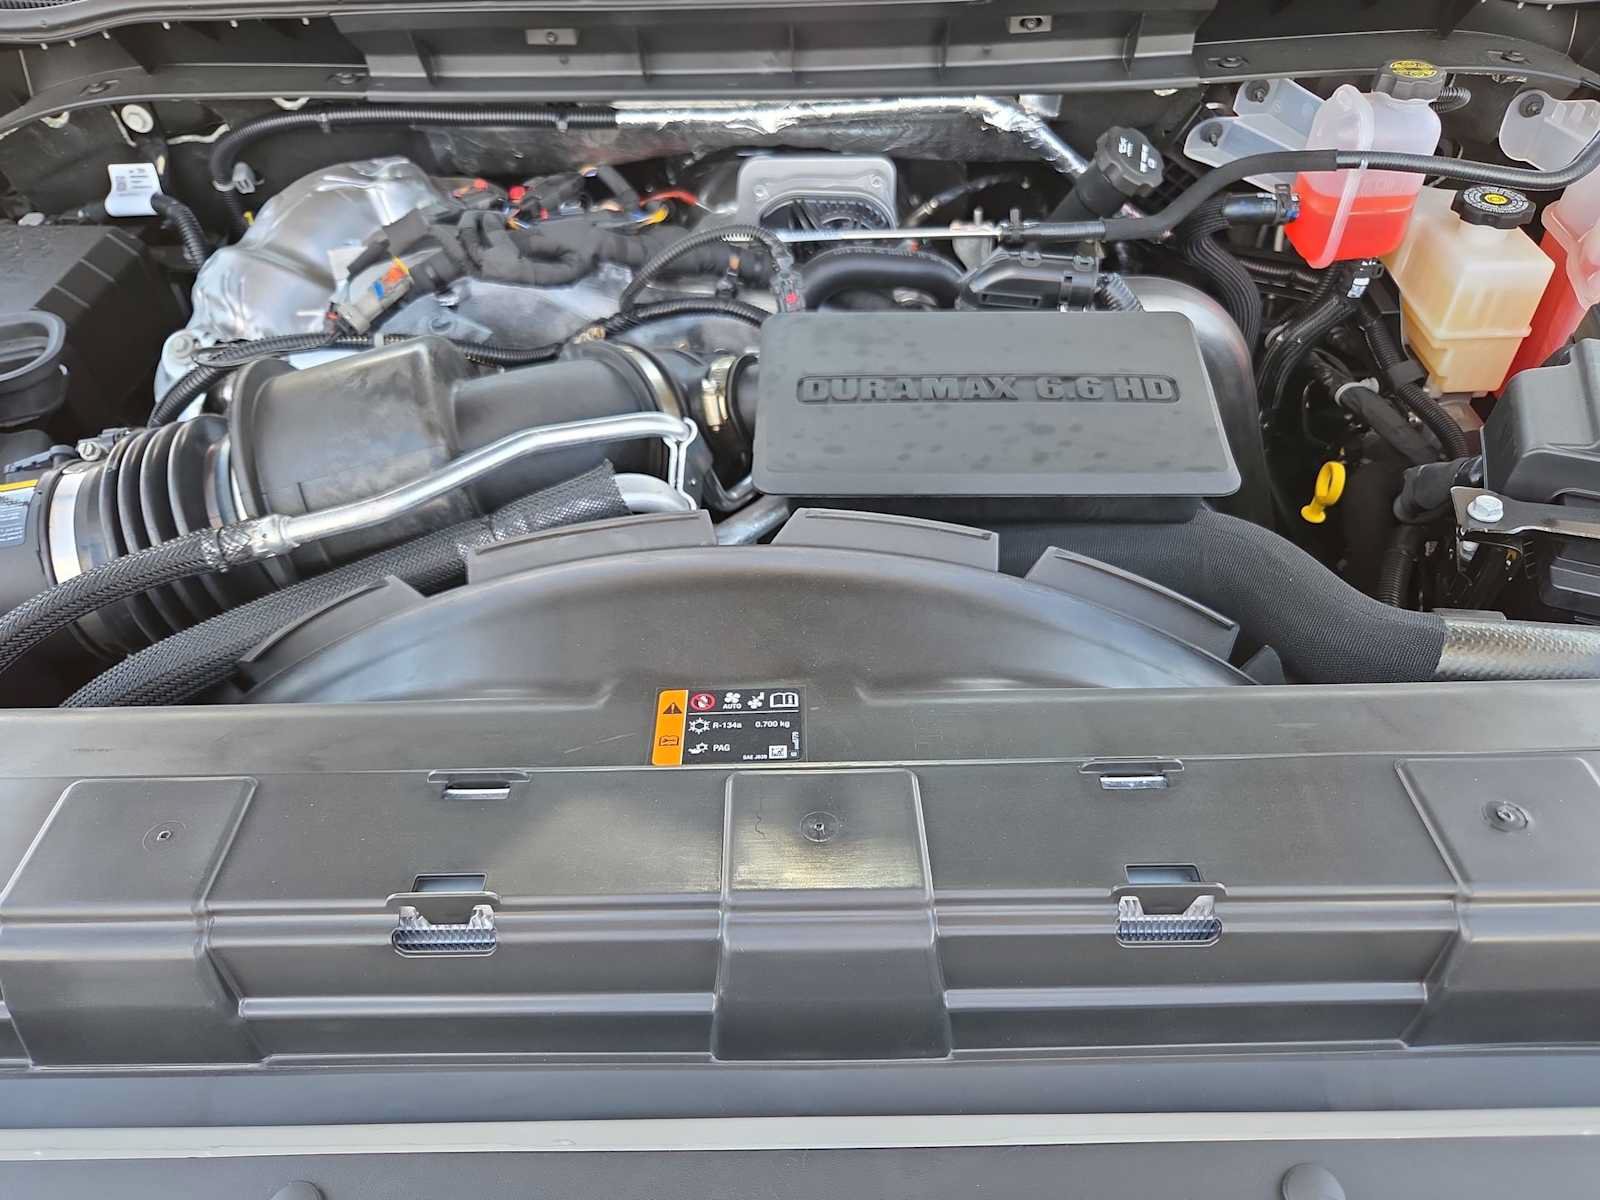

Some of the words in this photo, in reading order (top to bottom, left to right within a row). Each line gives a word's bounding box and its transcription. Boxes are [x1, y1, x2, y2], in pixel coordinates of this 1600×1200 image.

[802, 378, 1018, 401] DURAMAX
[1034, 376, 1105, 399] 6.6
[1113, 376, 1177, 399] HD
[755, 720, 778, 728] 0.700
[779, 720, 790, 728] kg
[713, 744, 730, 752] PAG
